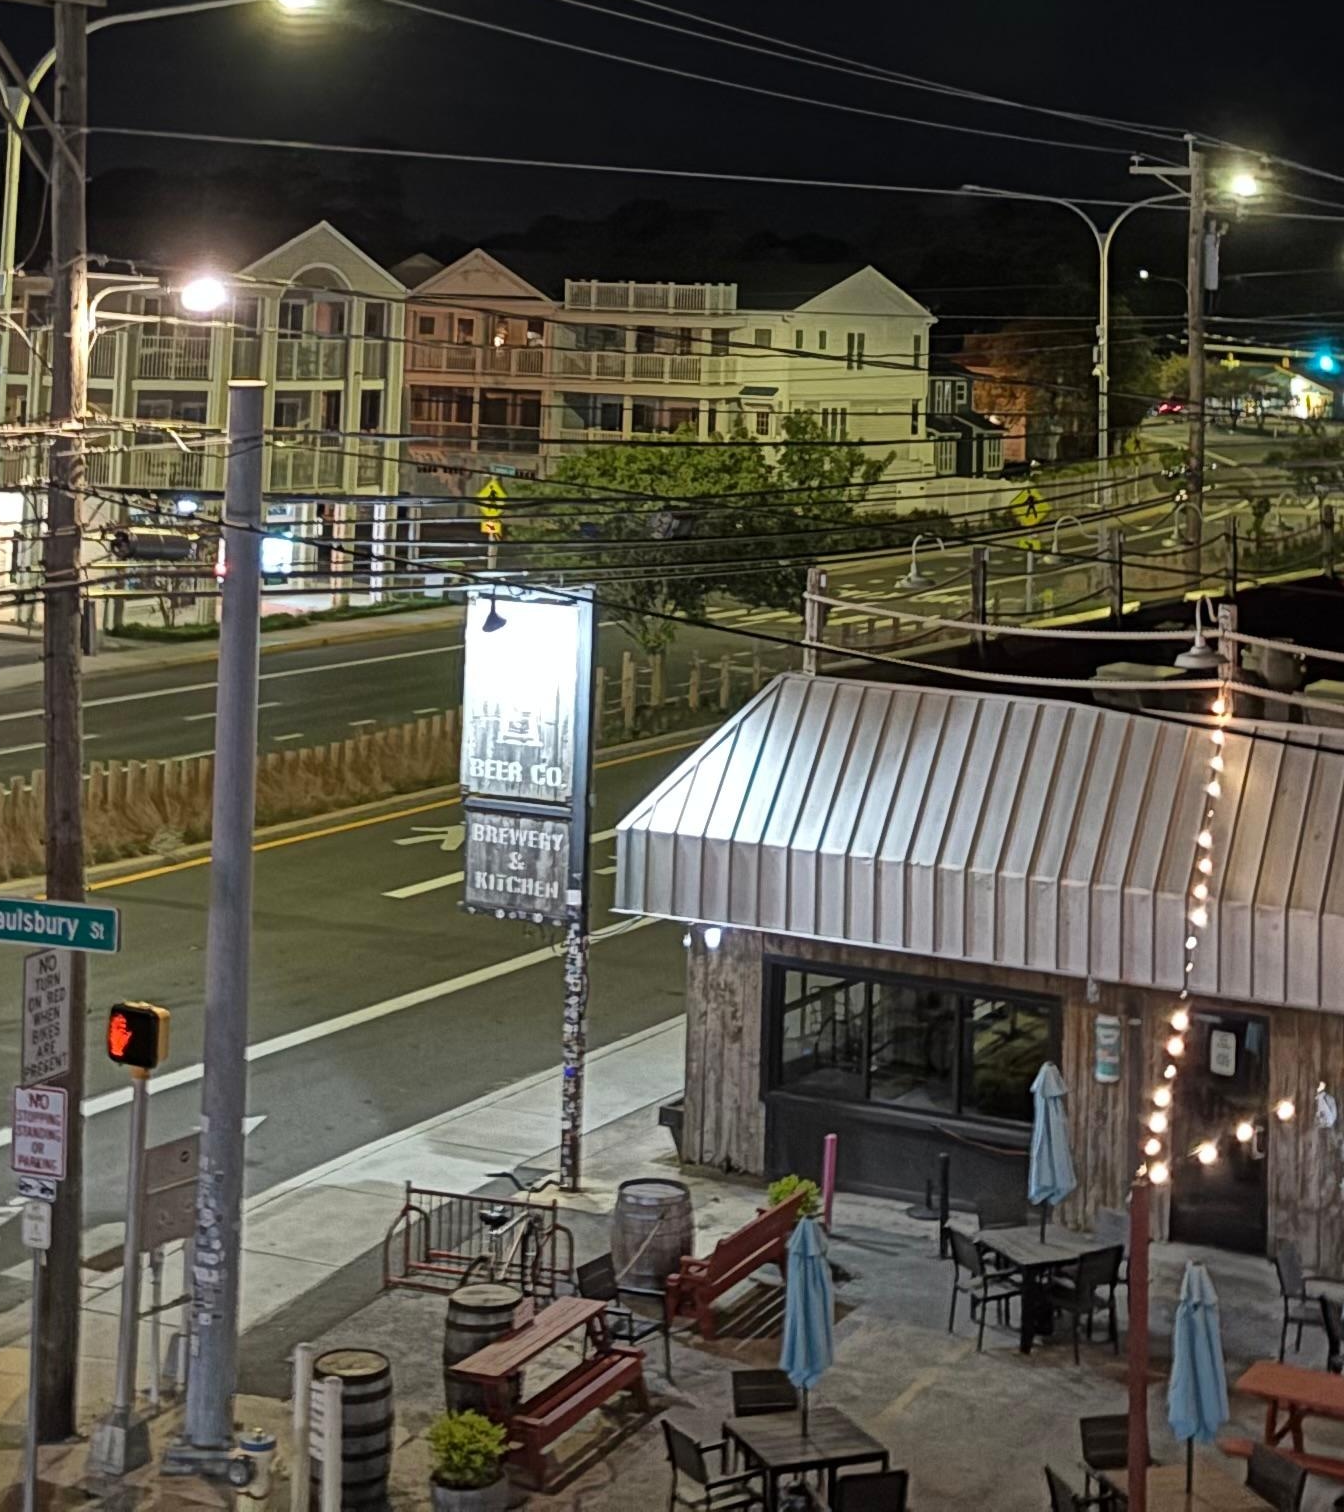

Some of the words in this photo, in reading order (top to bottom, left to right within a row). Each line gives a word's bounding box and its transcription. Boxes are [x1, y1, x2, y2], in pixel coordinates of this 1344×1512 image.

[470, 756, 523, 783] BEER
[530, 762, 567, 789] CO.
[471, 822, 563, 852] BREWERY
[507, 851, 526, 871] &
[474, 870, 559, 899] KITCHEN
[89, 921, 105, 940] St
[38, 954, 58, 975] NO
[35, 972, 61, 991] TURN
[28, 996, 42, 1013] ON
[33, 1006, 61, 1026] WHEN
[32, 1021, 61, 1045] BIKES
[37, 1040, 56, 1057] ARE
[23, 1051, 67, 1079] PRESENT
[28, 1093, 50, 1110] NO
[15, 1125, 62, 1142] STANDING
[31, 1141, 46, 1155] OR
[17, 1154, 58, 1172] PARKING
